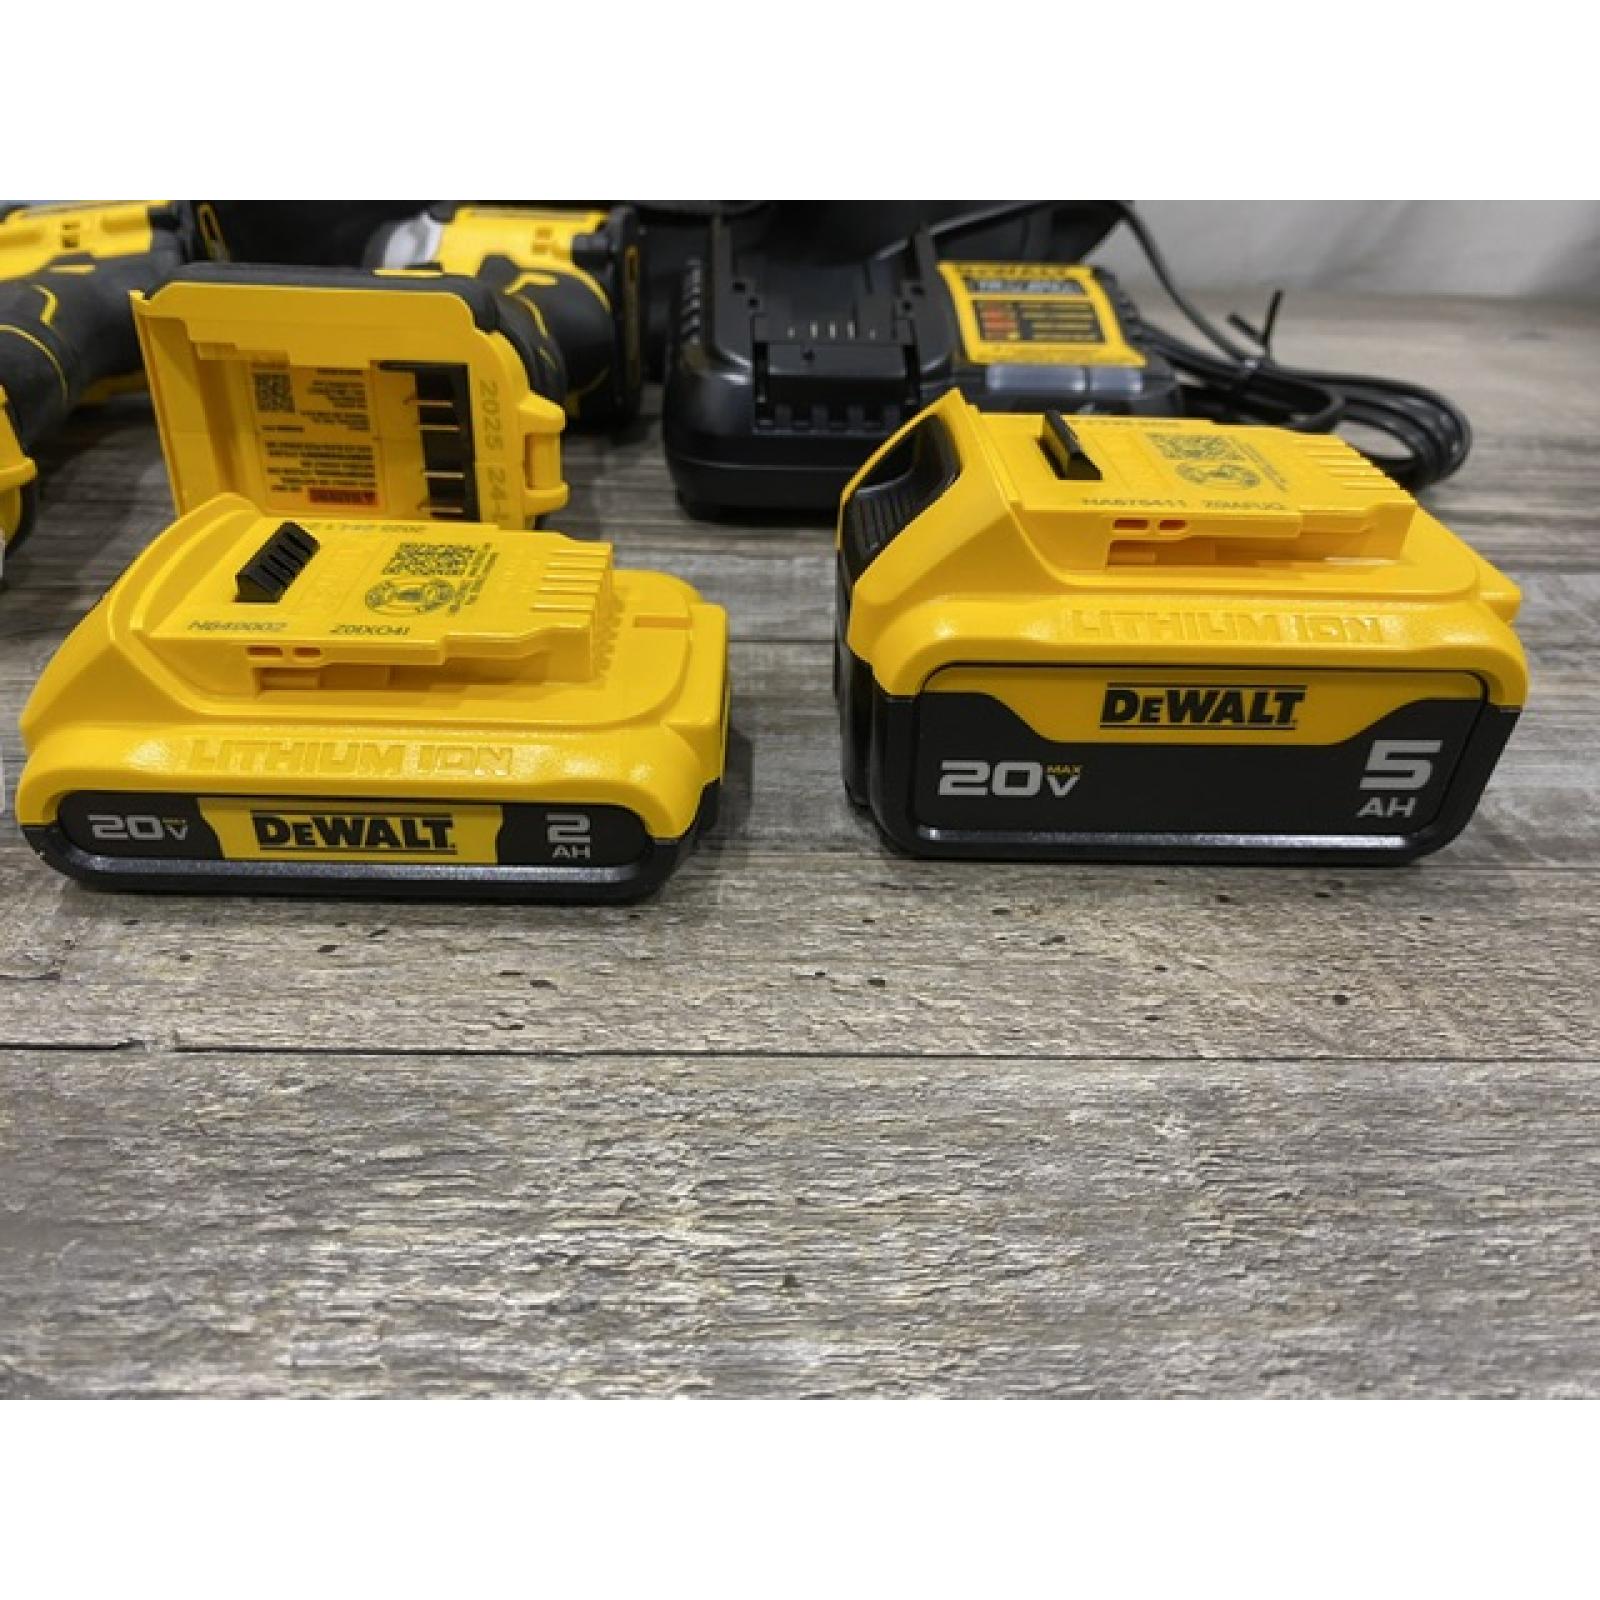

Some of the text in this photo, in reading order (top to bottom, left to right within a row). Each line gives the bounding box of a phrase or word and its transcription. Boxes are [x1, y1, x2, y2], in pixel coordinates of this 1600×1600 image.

[1071, 609, 1392, 643] LITHIUM ION
[189, 738, 513, 777] LITHIUM ION
[1359, 739, 1443, 791] 5
[1356, 796, 1417, 818] AH
[547, 813, 591, 843] 2
[551, 844, 591, 858] AH
